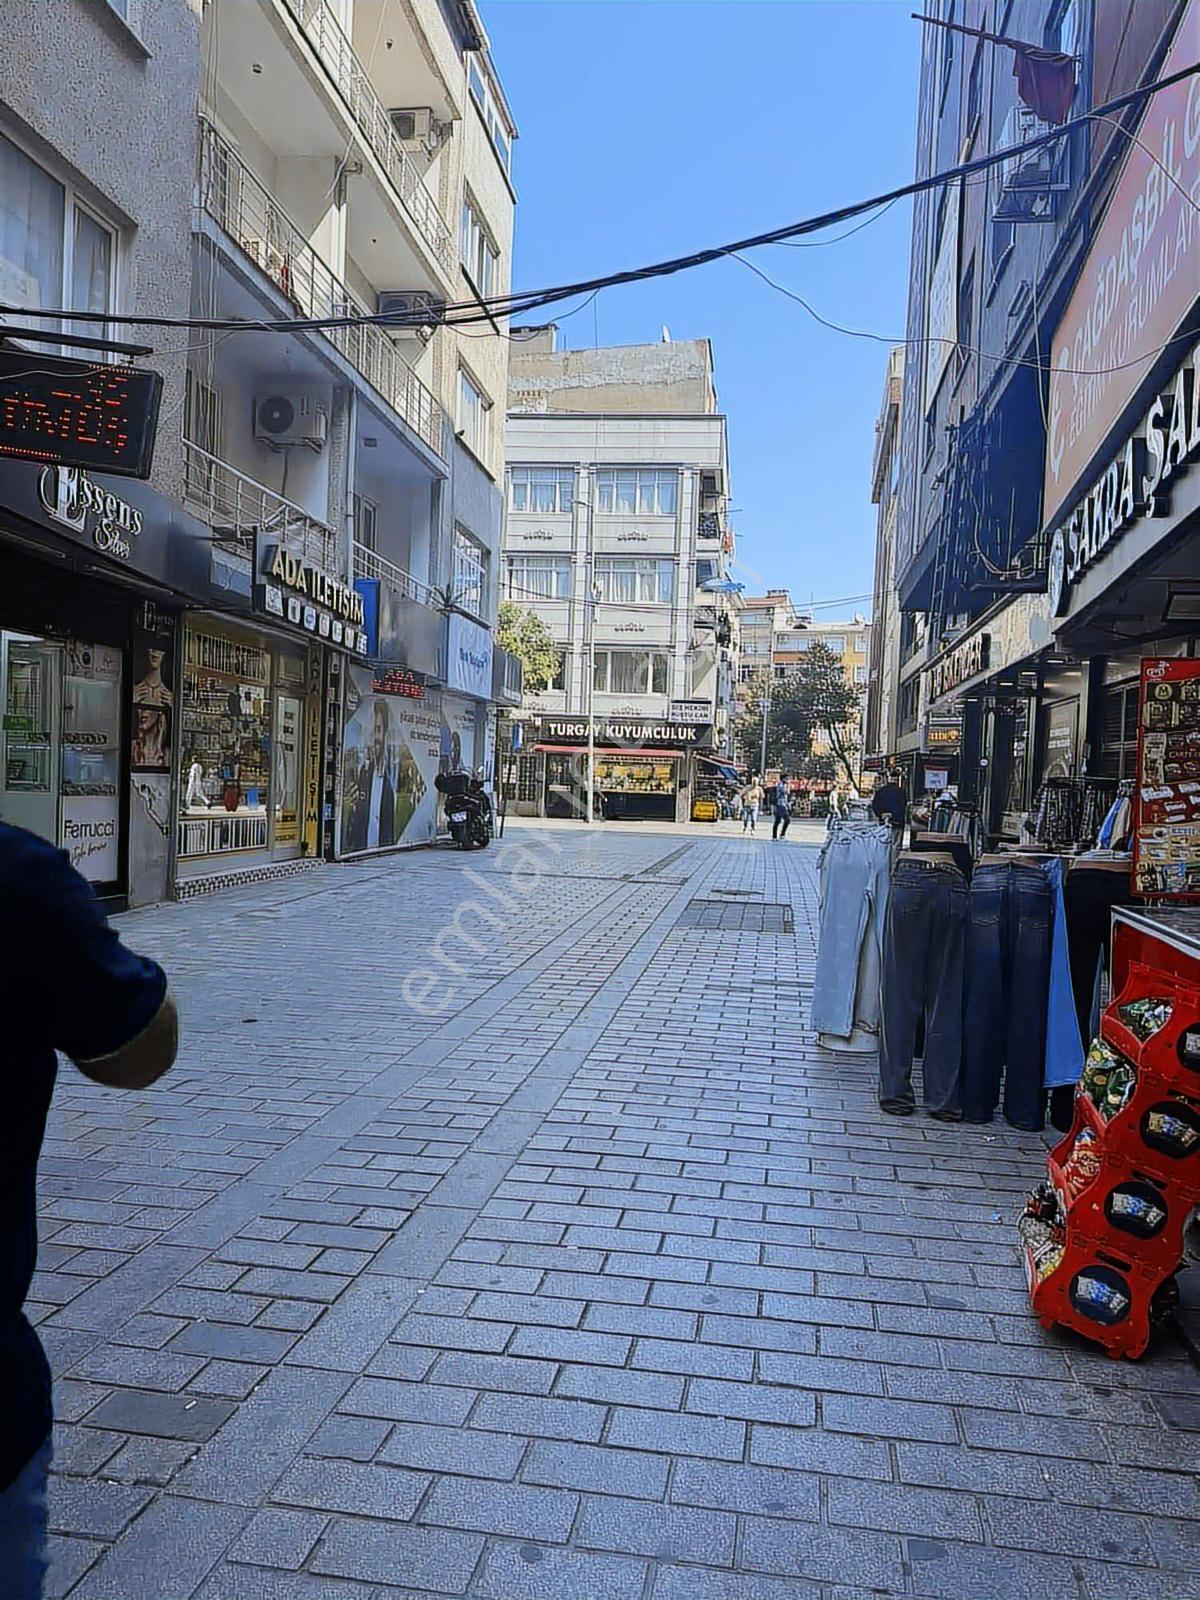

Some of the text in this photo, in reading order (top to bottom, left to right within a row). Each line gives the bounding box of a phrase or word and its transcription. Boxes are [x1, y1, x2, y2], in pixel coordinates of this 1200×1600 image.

[272, 543, 308, 593] ADA
[549, 723, 697, 741] TURGAY KUYUMCULUK
[64, 818, 116, 840] Ferrucci
